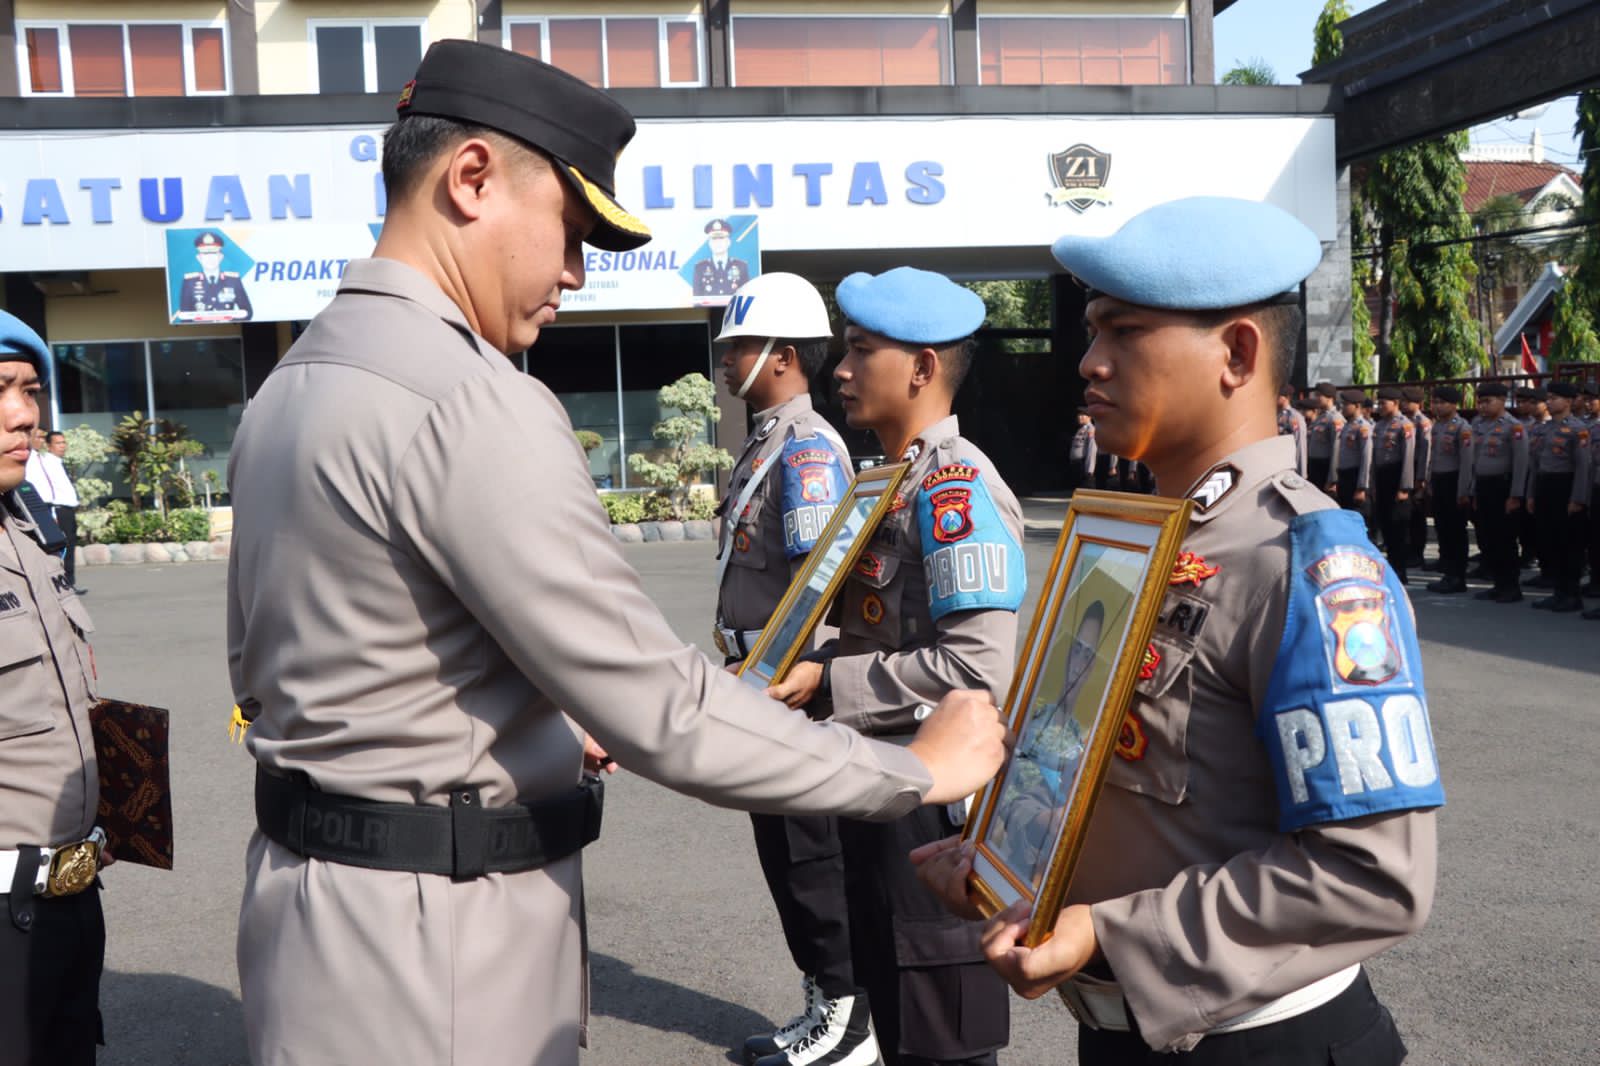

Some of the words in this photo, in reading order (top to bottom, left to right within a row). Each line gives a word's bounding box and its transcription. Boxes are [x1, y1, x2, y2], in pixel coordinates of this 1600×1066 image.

[1065, 156, 1098, 177] ZI
[0, 174, 313, 226] ATUAN
[643, 160, 947, 209] LINTAS
[254, 259, 349, 282] PROAKT
[585, 250, 680, 272] ESIONAL
[783, 505, 838, 548] PRO
[924, 542, 1008, 604] PROV
[1275, 694, 1438, 804] PRO
